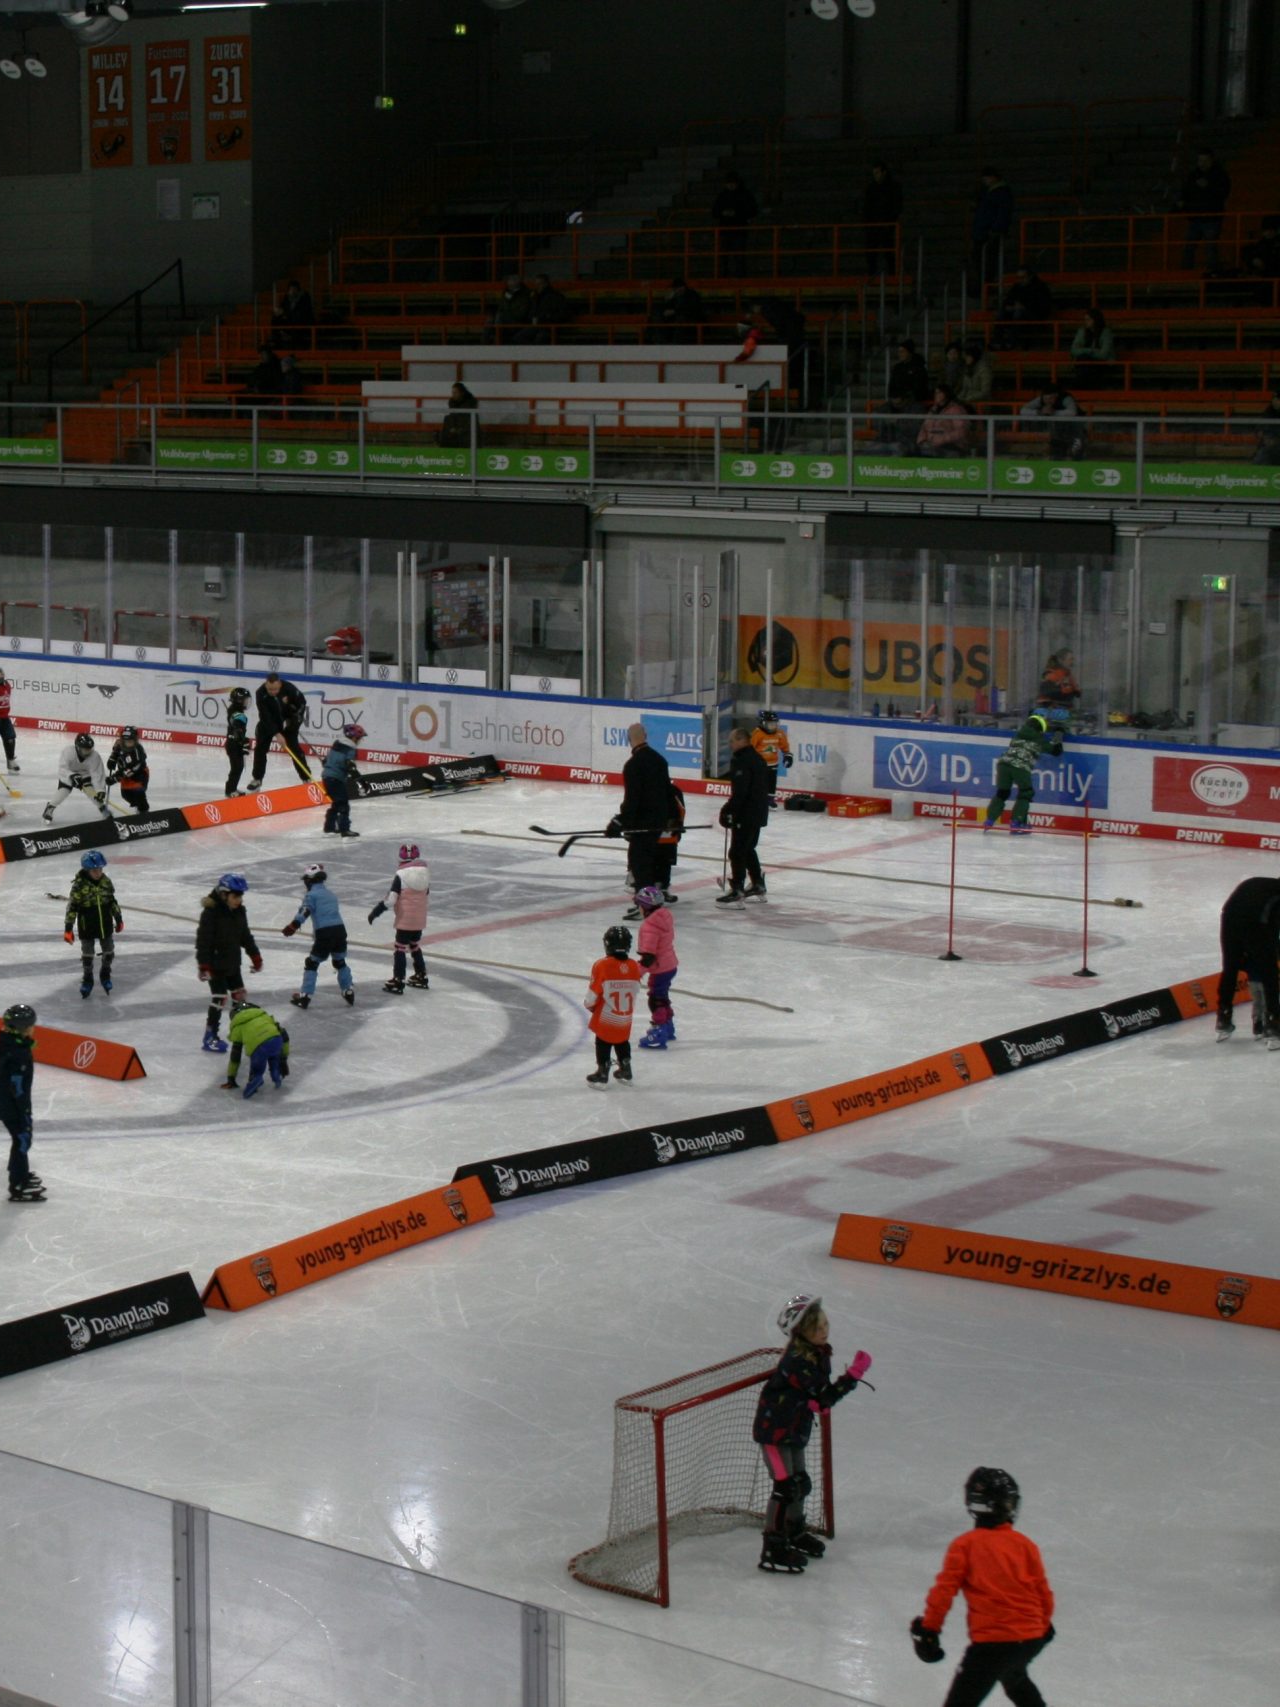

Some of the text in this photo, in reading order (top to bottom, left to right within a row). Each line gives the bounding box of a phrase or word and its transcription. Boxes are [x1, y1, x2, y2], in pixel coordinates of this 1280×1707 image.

[92, 52, 128, 70] MILLEY
[210, 42, 244, 60] ZUREK
[95, 74, 125, 113] 14
[149, 64, 186, 104] 17
[211, 65, 243, 105] 31
[368, 453, 452, 467] Wolfsburger Allgemeine
[858, 464, 963, 480] Wolfsburger Allgemeine
[1148, 473, 1268, 489] Wolfsburger Allgemeine
[823, 636, 991, 688] CUBOS
[8, 677, 81, 695] OLFSBURG
[164, 693, 230, 720] INJO
[460, 716, 564, 747] sahnefoto
[797, 743, 827, 764] LSW
[939, 753, 980, 785] ID.
[1199, 774, 1243, 788] Küchen
[608, 990, 635, 1017] 11
[832, 1068, 942, 1117] young-grizzlys.de
[295, 1209, 428, 1276] young-grizzlys.de
[944, 1243, 1172, 1295] young-grizzlys.de
